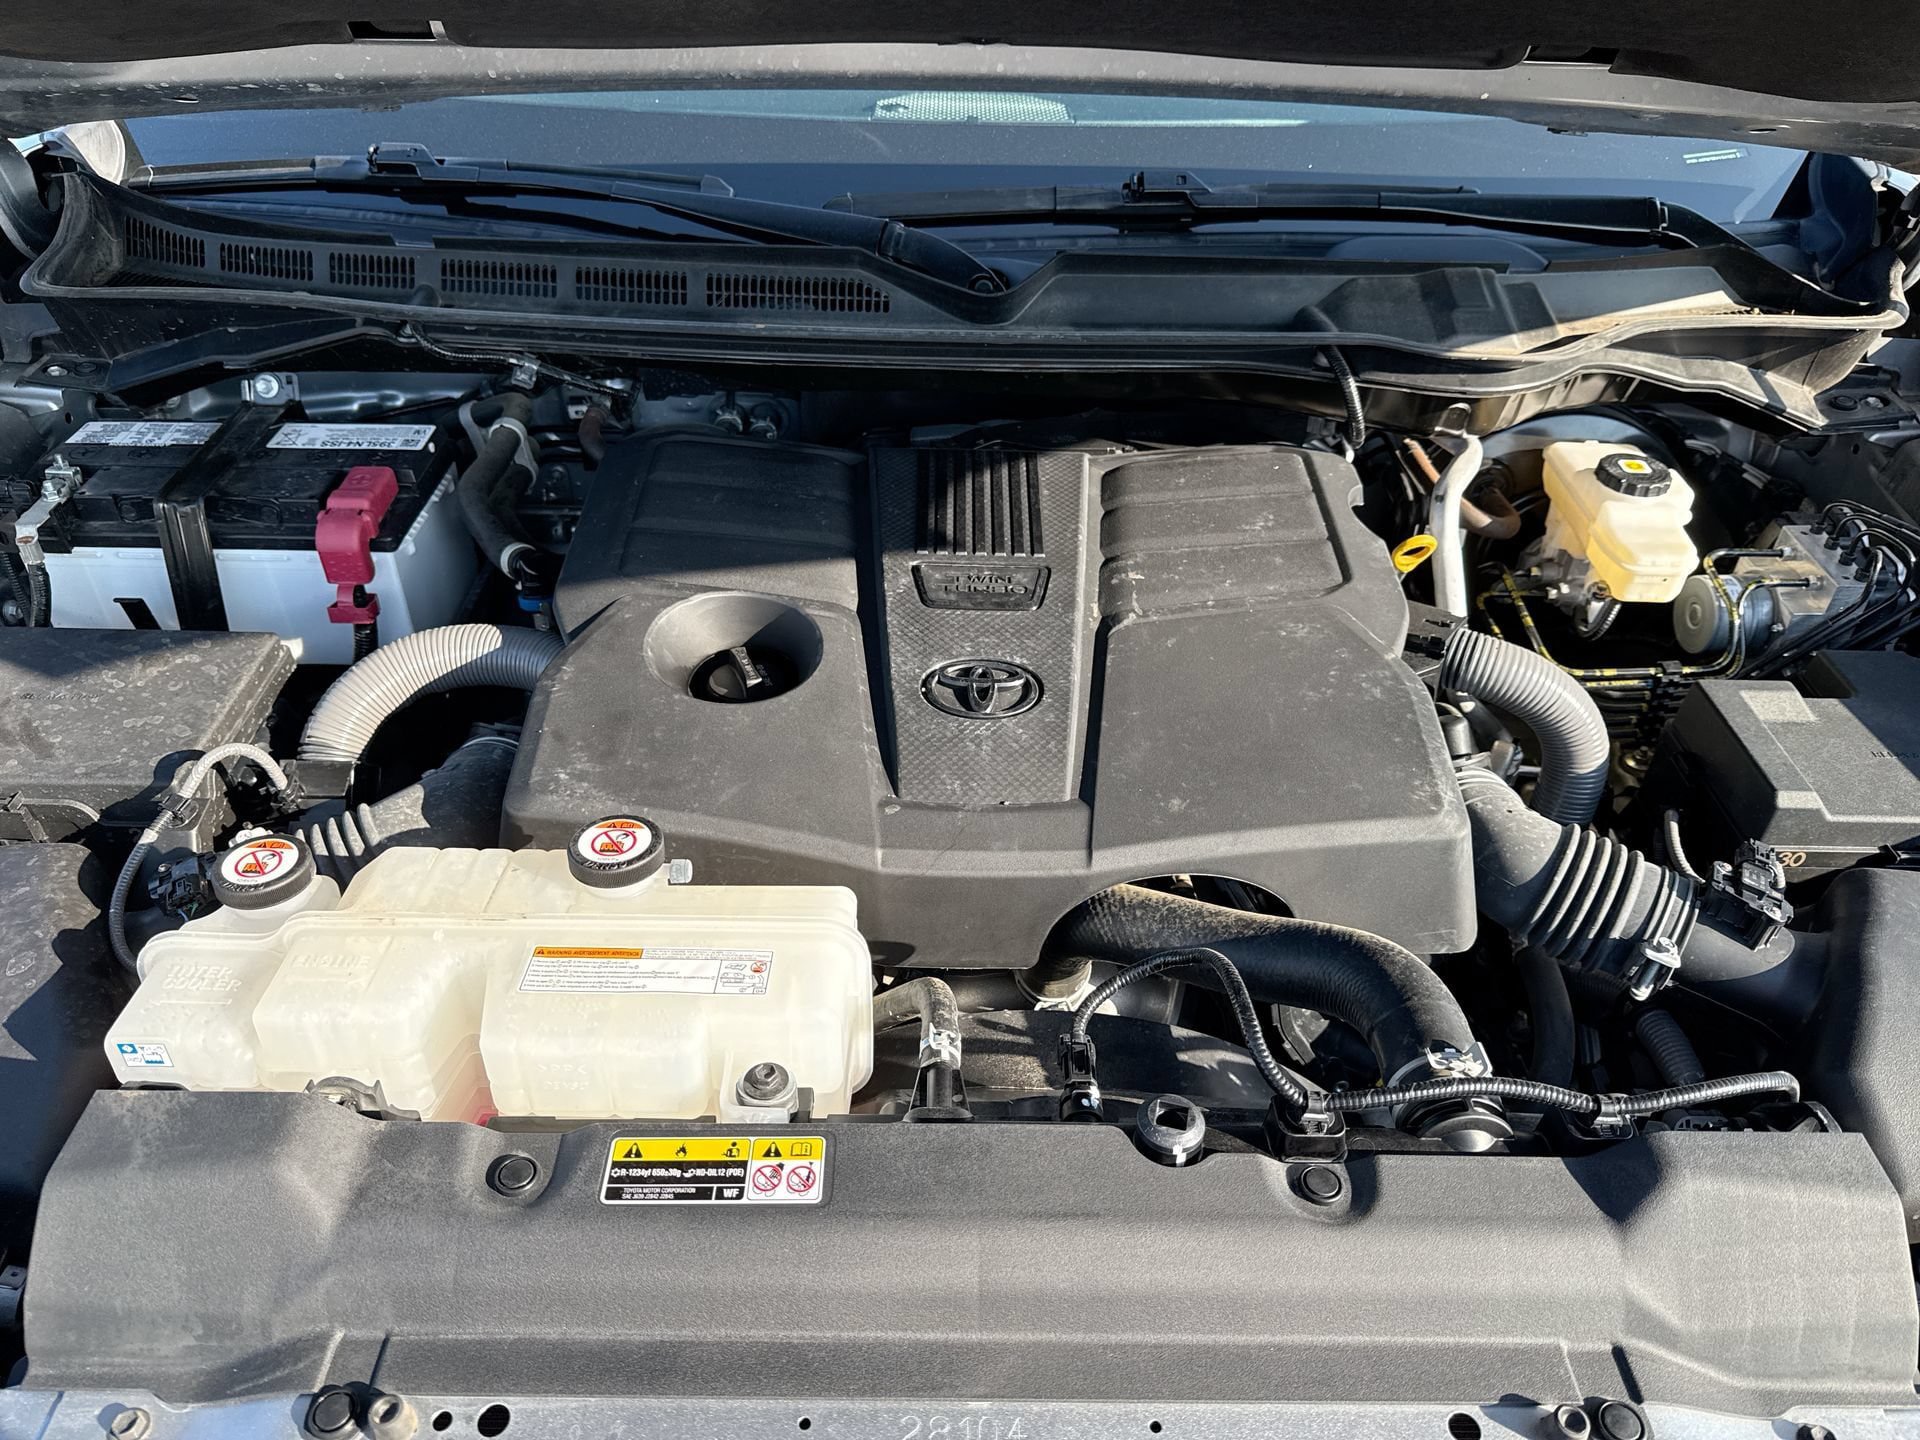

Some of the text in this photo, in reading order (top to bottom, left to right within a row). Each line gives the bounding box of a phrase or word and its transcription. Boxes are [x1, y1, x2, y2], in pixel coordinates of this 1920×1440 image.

[950, 574, 1012, 584] TWIN
[938, 584, 1028, 593] TURBO
[292, 953, 371, 969] ENGINE
[167, 964, 234, 979] INTER
[162, 978, 243, 992] COOLER
[723, 1188, 740, 1198] WF
